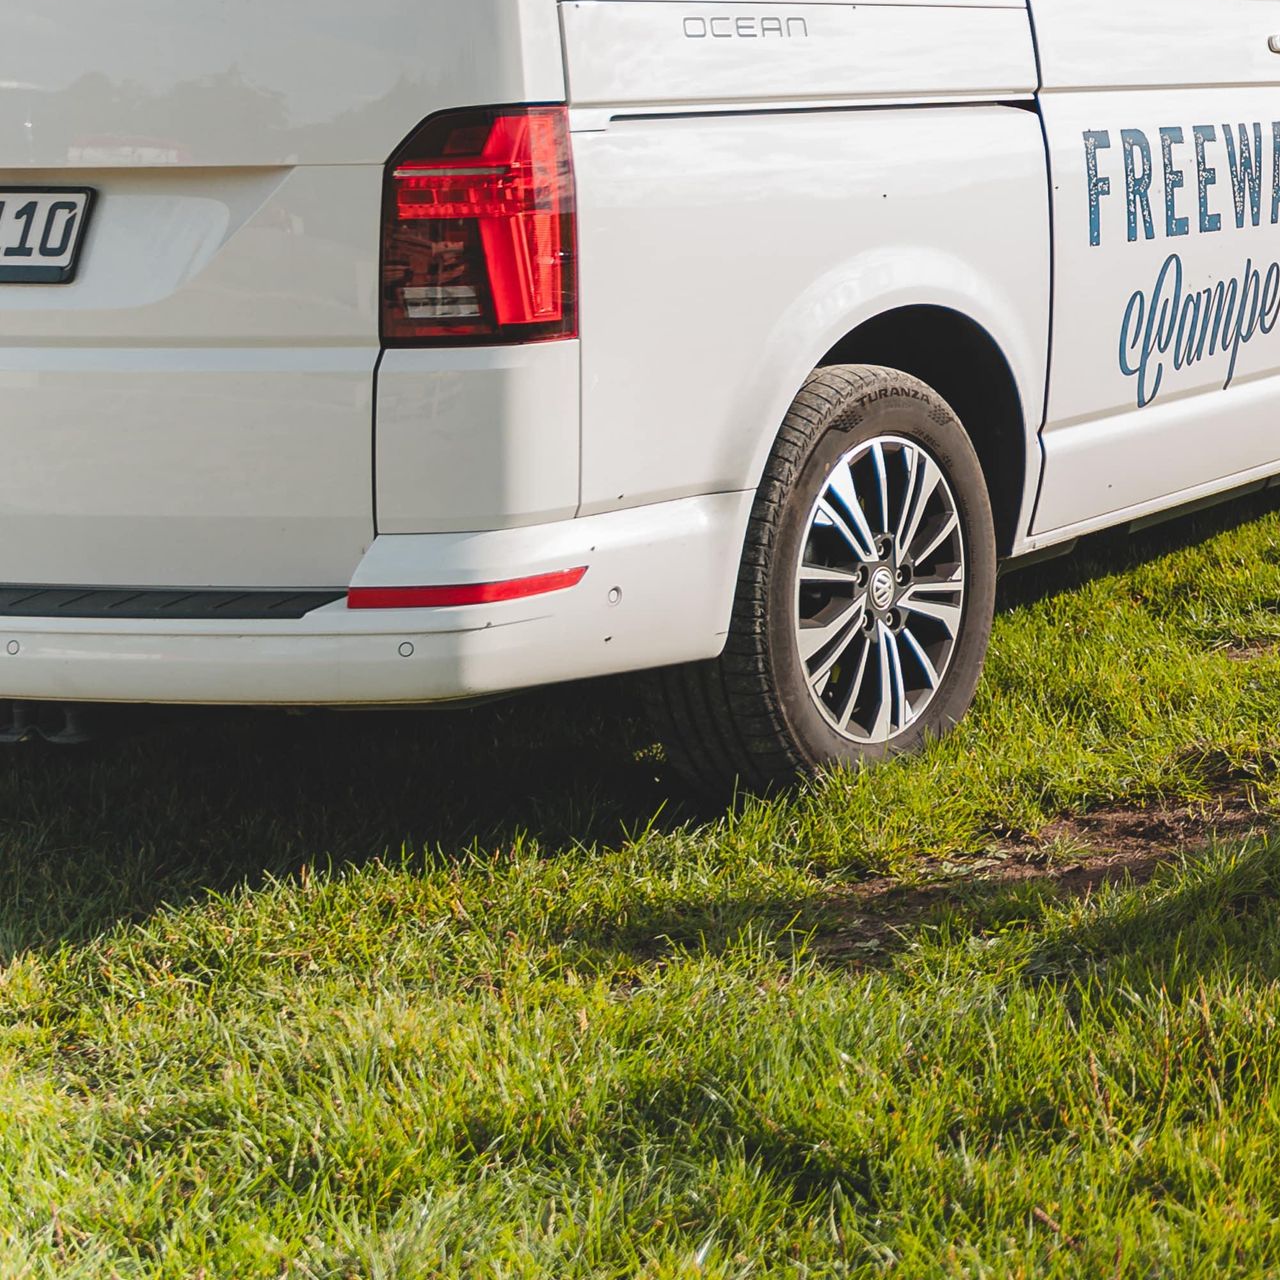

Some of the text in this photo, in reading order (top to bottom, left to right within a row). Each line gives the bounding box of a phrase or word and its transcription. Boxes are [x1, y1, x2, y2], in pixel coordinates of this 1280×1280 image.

[683, 17, 808, 38] OCEAN
[0, 201, 77, 257] 10
[857, 387, 931, 407] TURANZA
